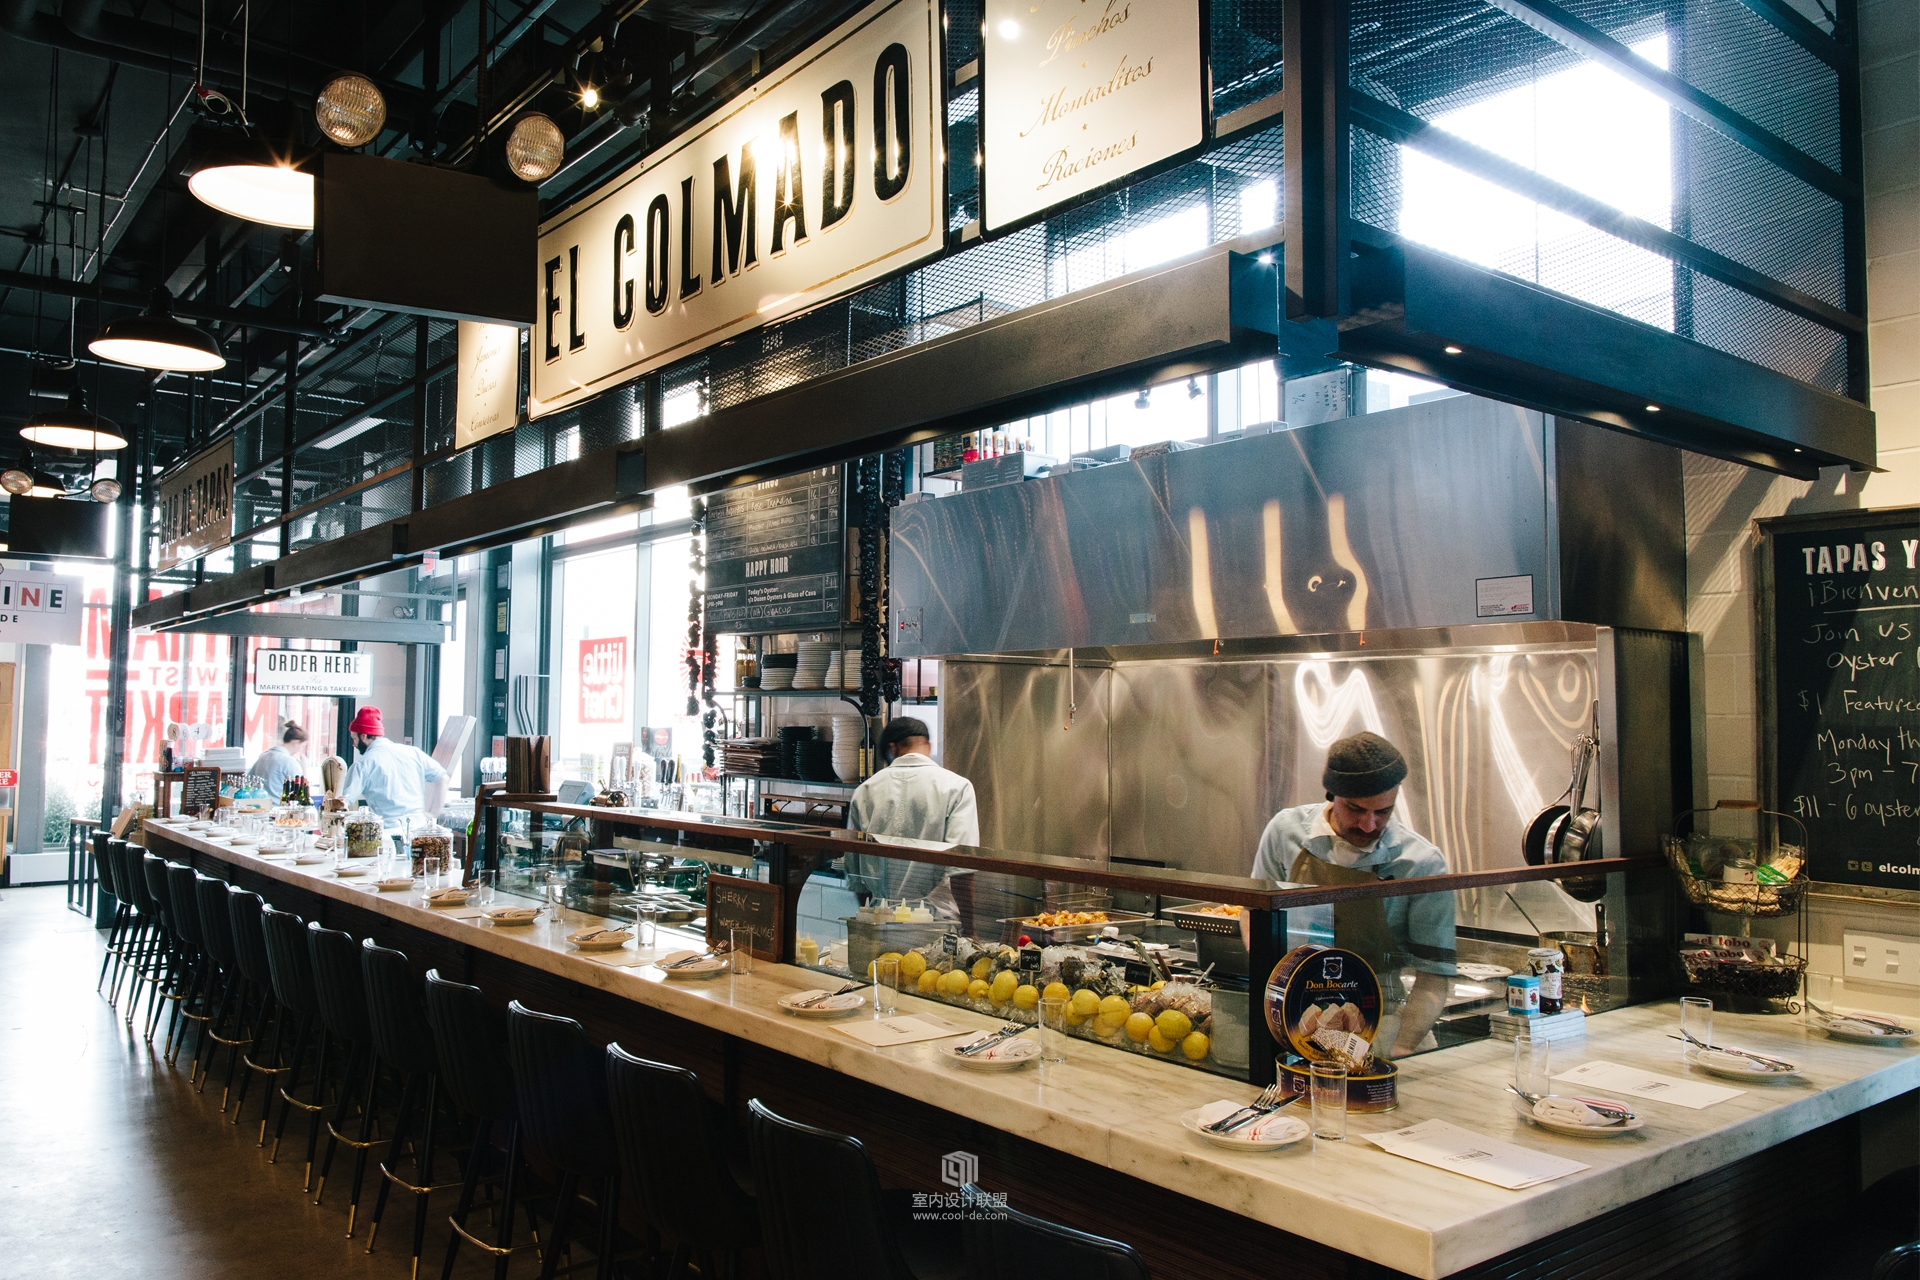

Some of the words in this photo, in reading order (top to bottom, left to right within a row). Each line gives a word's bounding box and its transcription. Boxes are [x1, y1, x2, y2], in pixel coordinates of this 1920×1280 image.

[1038, 0, 1131, 68] Pinchos
[1019, 54, 1154, 138] Montaditos
[1036, 129, 1139, 191] Raciones
[543, 244, 587, 365] EL
[611, 42, 914, 333] COLMADO
[745, 560, 768, 578] HAPPY
[769, 556, 789, 575] HOUR
[1801, 541, 1887, 576] TAPAS
[1901, 539, 1919, 569] Y
[754, 594, 767, 603] Dozen
[766, 593, 783, 602] Oysters
[787, 591, 800, 600] Glass
[1802, 622, 1861, 644] Join
[268, 653, 318, 672] ORDER
[324, 655, 361, 674] HERE
[1826, 651, 1903, 682] Oyster
[306, 674, 322, 684] For
[330, 685, 367, 693] TAKEAWAY
[1797, 690, 1823, 716] $1
[1817, 729, 1891, 766] Monday
[1827, 762, 1873, 788] 3pm
[1794, 795, 1820, 818] $11
[1846, 793, 1858, 820] 6
[715, 886, 748, 911] SHERRY
[1713, 950, 1745, 959] lobo
[1718, 937, 1750, 948] lobo
[1305, 980, 1324, 989] Don
[1326, 979, 1358, 989] Bocarte
